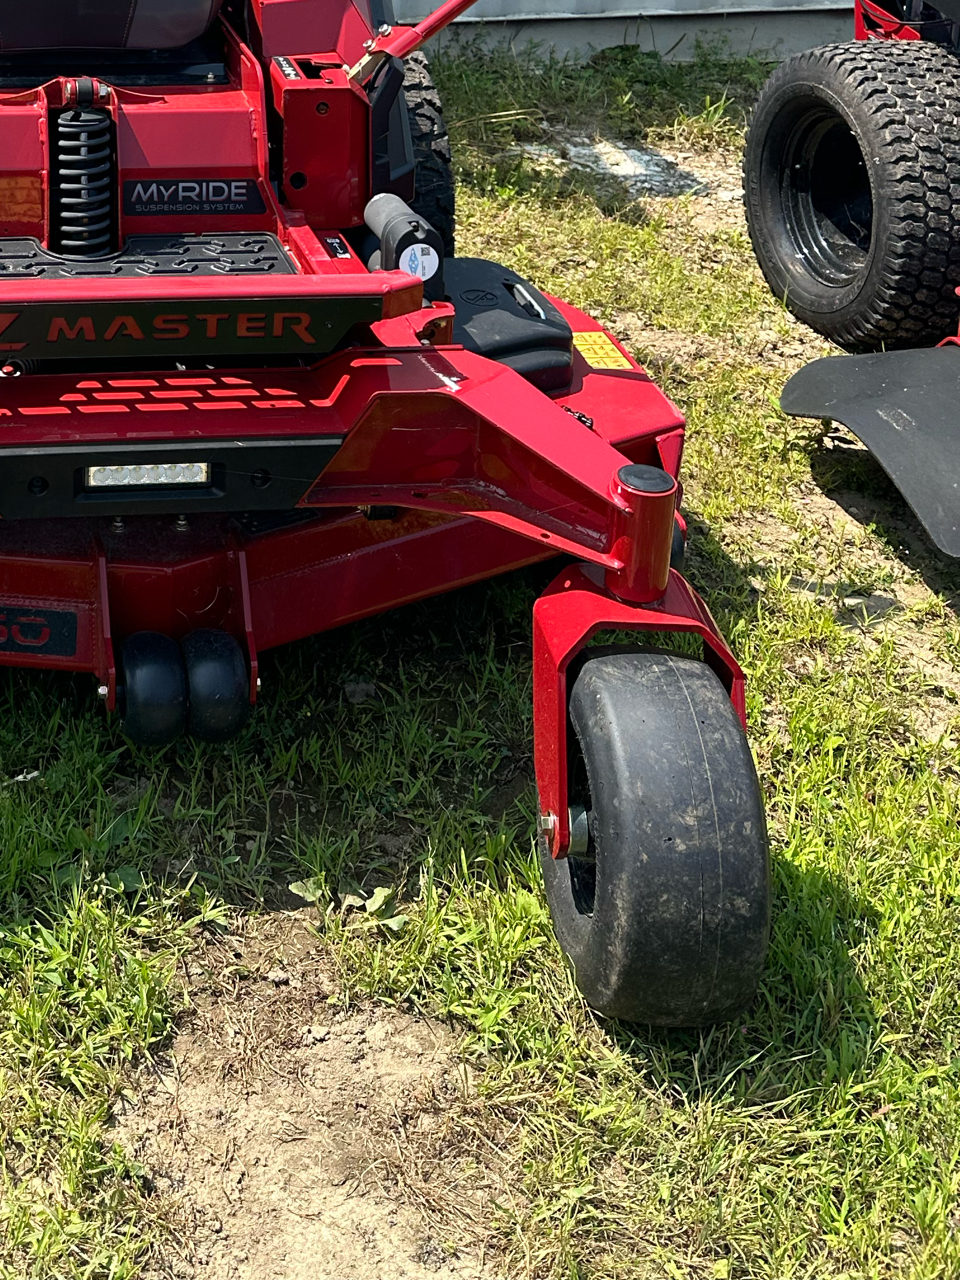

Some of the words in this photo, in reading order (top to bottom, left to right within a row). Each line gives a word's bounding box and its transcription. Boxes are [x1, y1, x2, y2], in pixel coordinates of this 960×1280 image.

[135, 204, 200, 212] SUSPENSION
[203, 203, 244, 211] SYSTEM
[46, 311, 317, 344] MASTER
